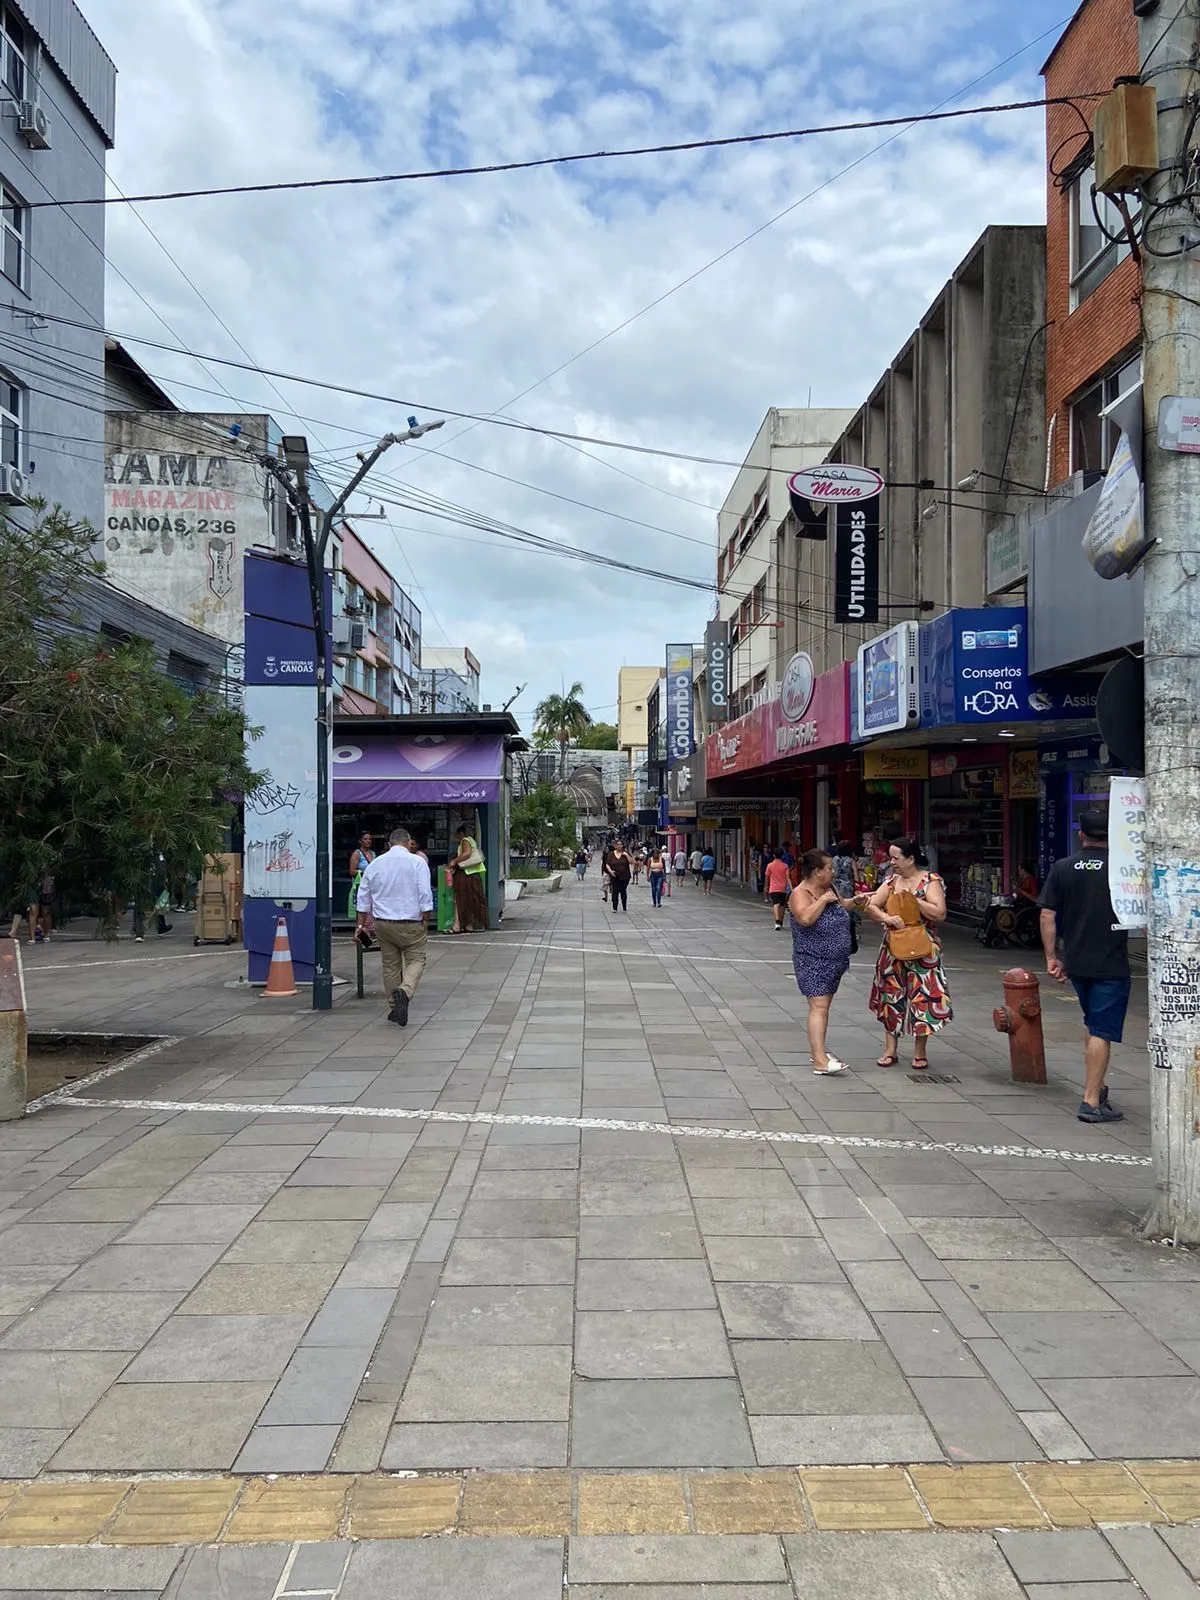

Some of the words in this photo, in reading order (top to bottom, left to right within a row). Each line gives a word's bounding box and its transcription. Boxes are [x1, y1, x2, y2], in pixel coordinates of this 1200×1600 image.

[812, 470, 849, 480] CASA
[811, 481, 862, 497] Maria
[198, 519, 236, 534] 236
[848, 510, 866, 618] UTILIDADES
[280, 665, 314, 673] CANOAS
[962, 667, 1022, 679] Consertos
[995, 680, 1012, 690] na
[964, 690, 1019, 714] HORA
[672, 675, 690, 760] Colombo
